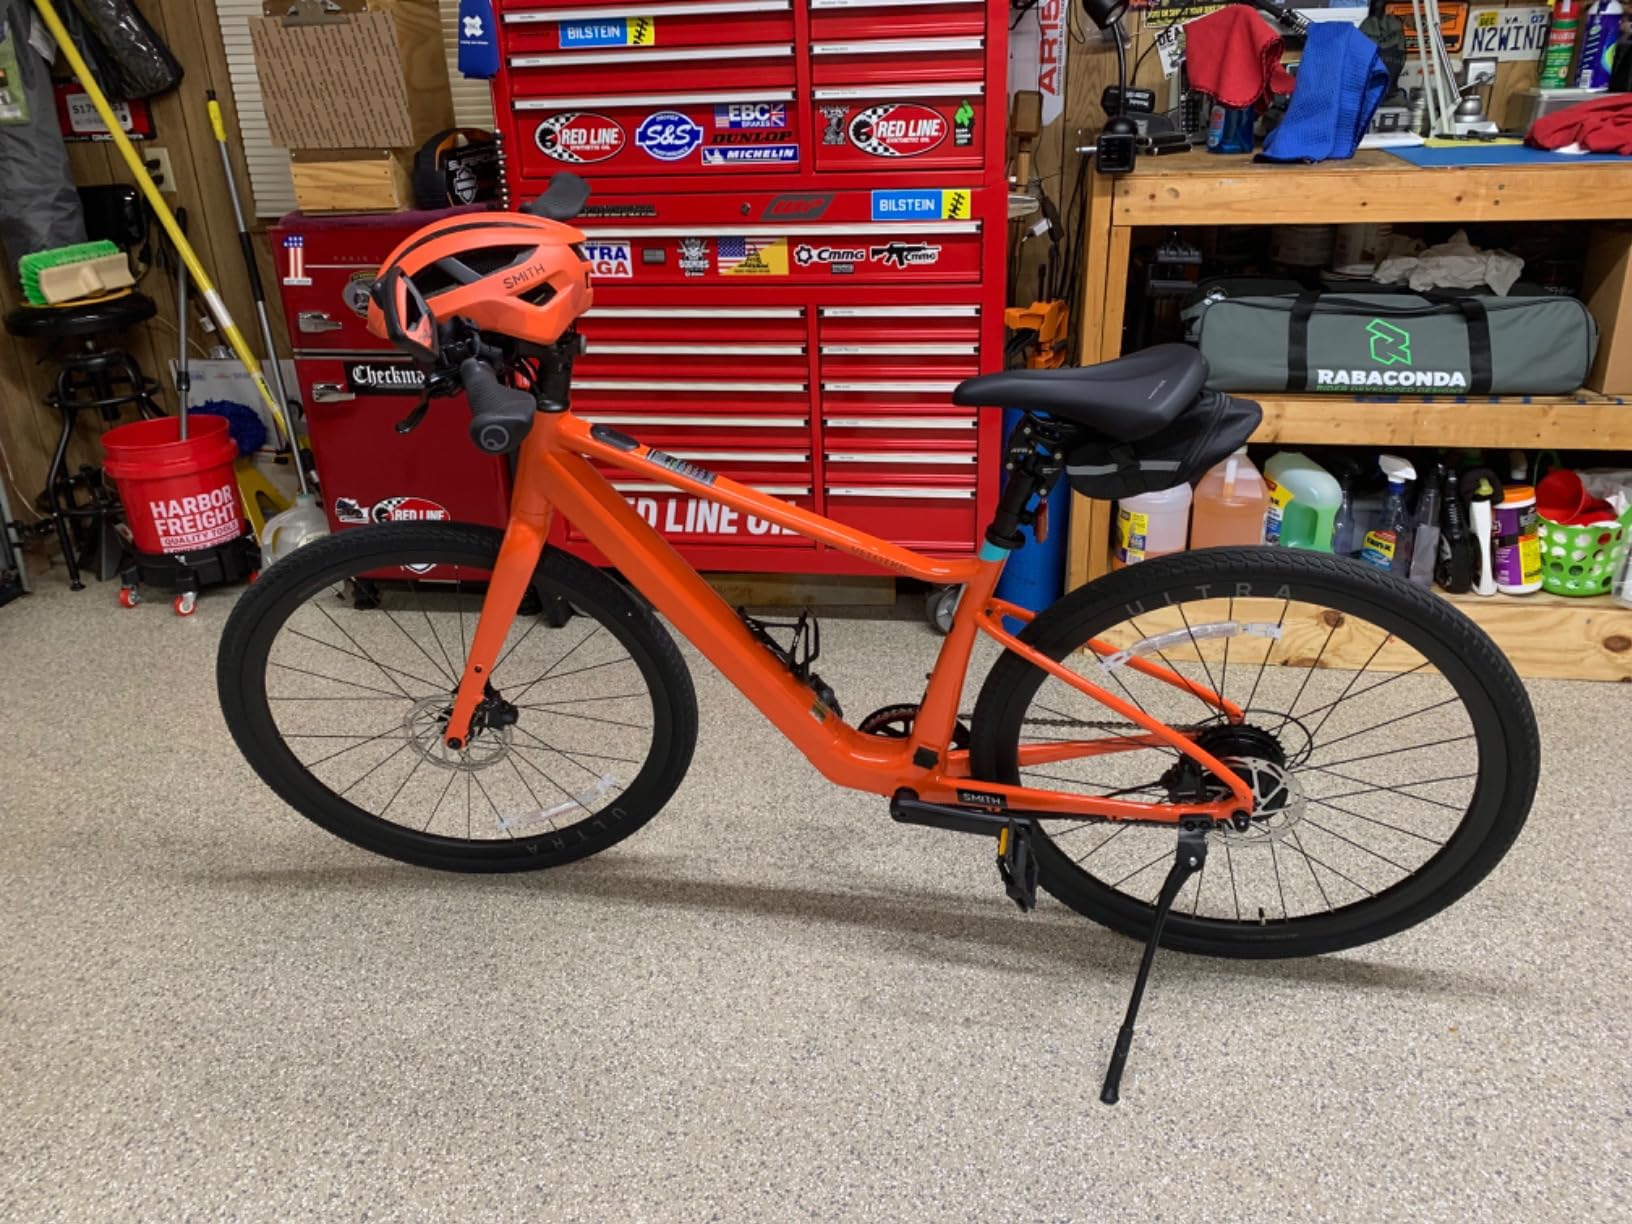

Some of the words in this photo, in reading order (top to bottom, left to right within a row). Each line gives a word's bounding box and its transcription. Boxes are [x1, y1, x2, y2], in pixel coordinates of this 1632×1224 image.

[567, 25, 621, 39] BILSTEIN
[729, 104, 770, 121] EBC
[562, 128, 587, 145] RED
[590, 128, 619, 144] LINE
[645, 124, 692, 146] S&S
[877, 120, 905, 137] RED
[908, 119, 941, 137] LINE
[712, 131, 792, 144] DUNLOP
[727, 148, 794, 159] MICHELIN
[879, 198, 935, 212] BILSTEIN
[585, 246, 628, 261] TRA
[503, 263, 546, 290] SMITH
[352, 364, 425, 385] Checkma
[1317, 369, 1467, 387] RABACONDA
[149, 485, 233, 518] HARBOR
[154, 502, 235, 536] FREIGHT
[395, 509, 417, 521] RED
[665, 498, 739, 534] LINE
[164, 532, 209, 546] QUALITY
[212, 522, 237, 537] TOOLS
[1125, 582, 1292, 616] ULTRA
[963, 792, 1001, 805] SMITH
[527, 807, 627, 854] ULTRA
